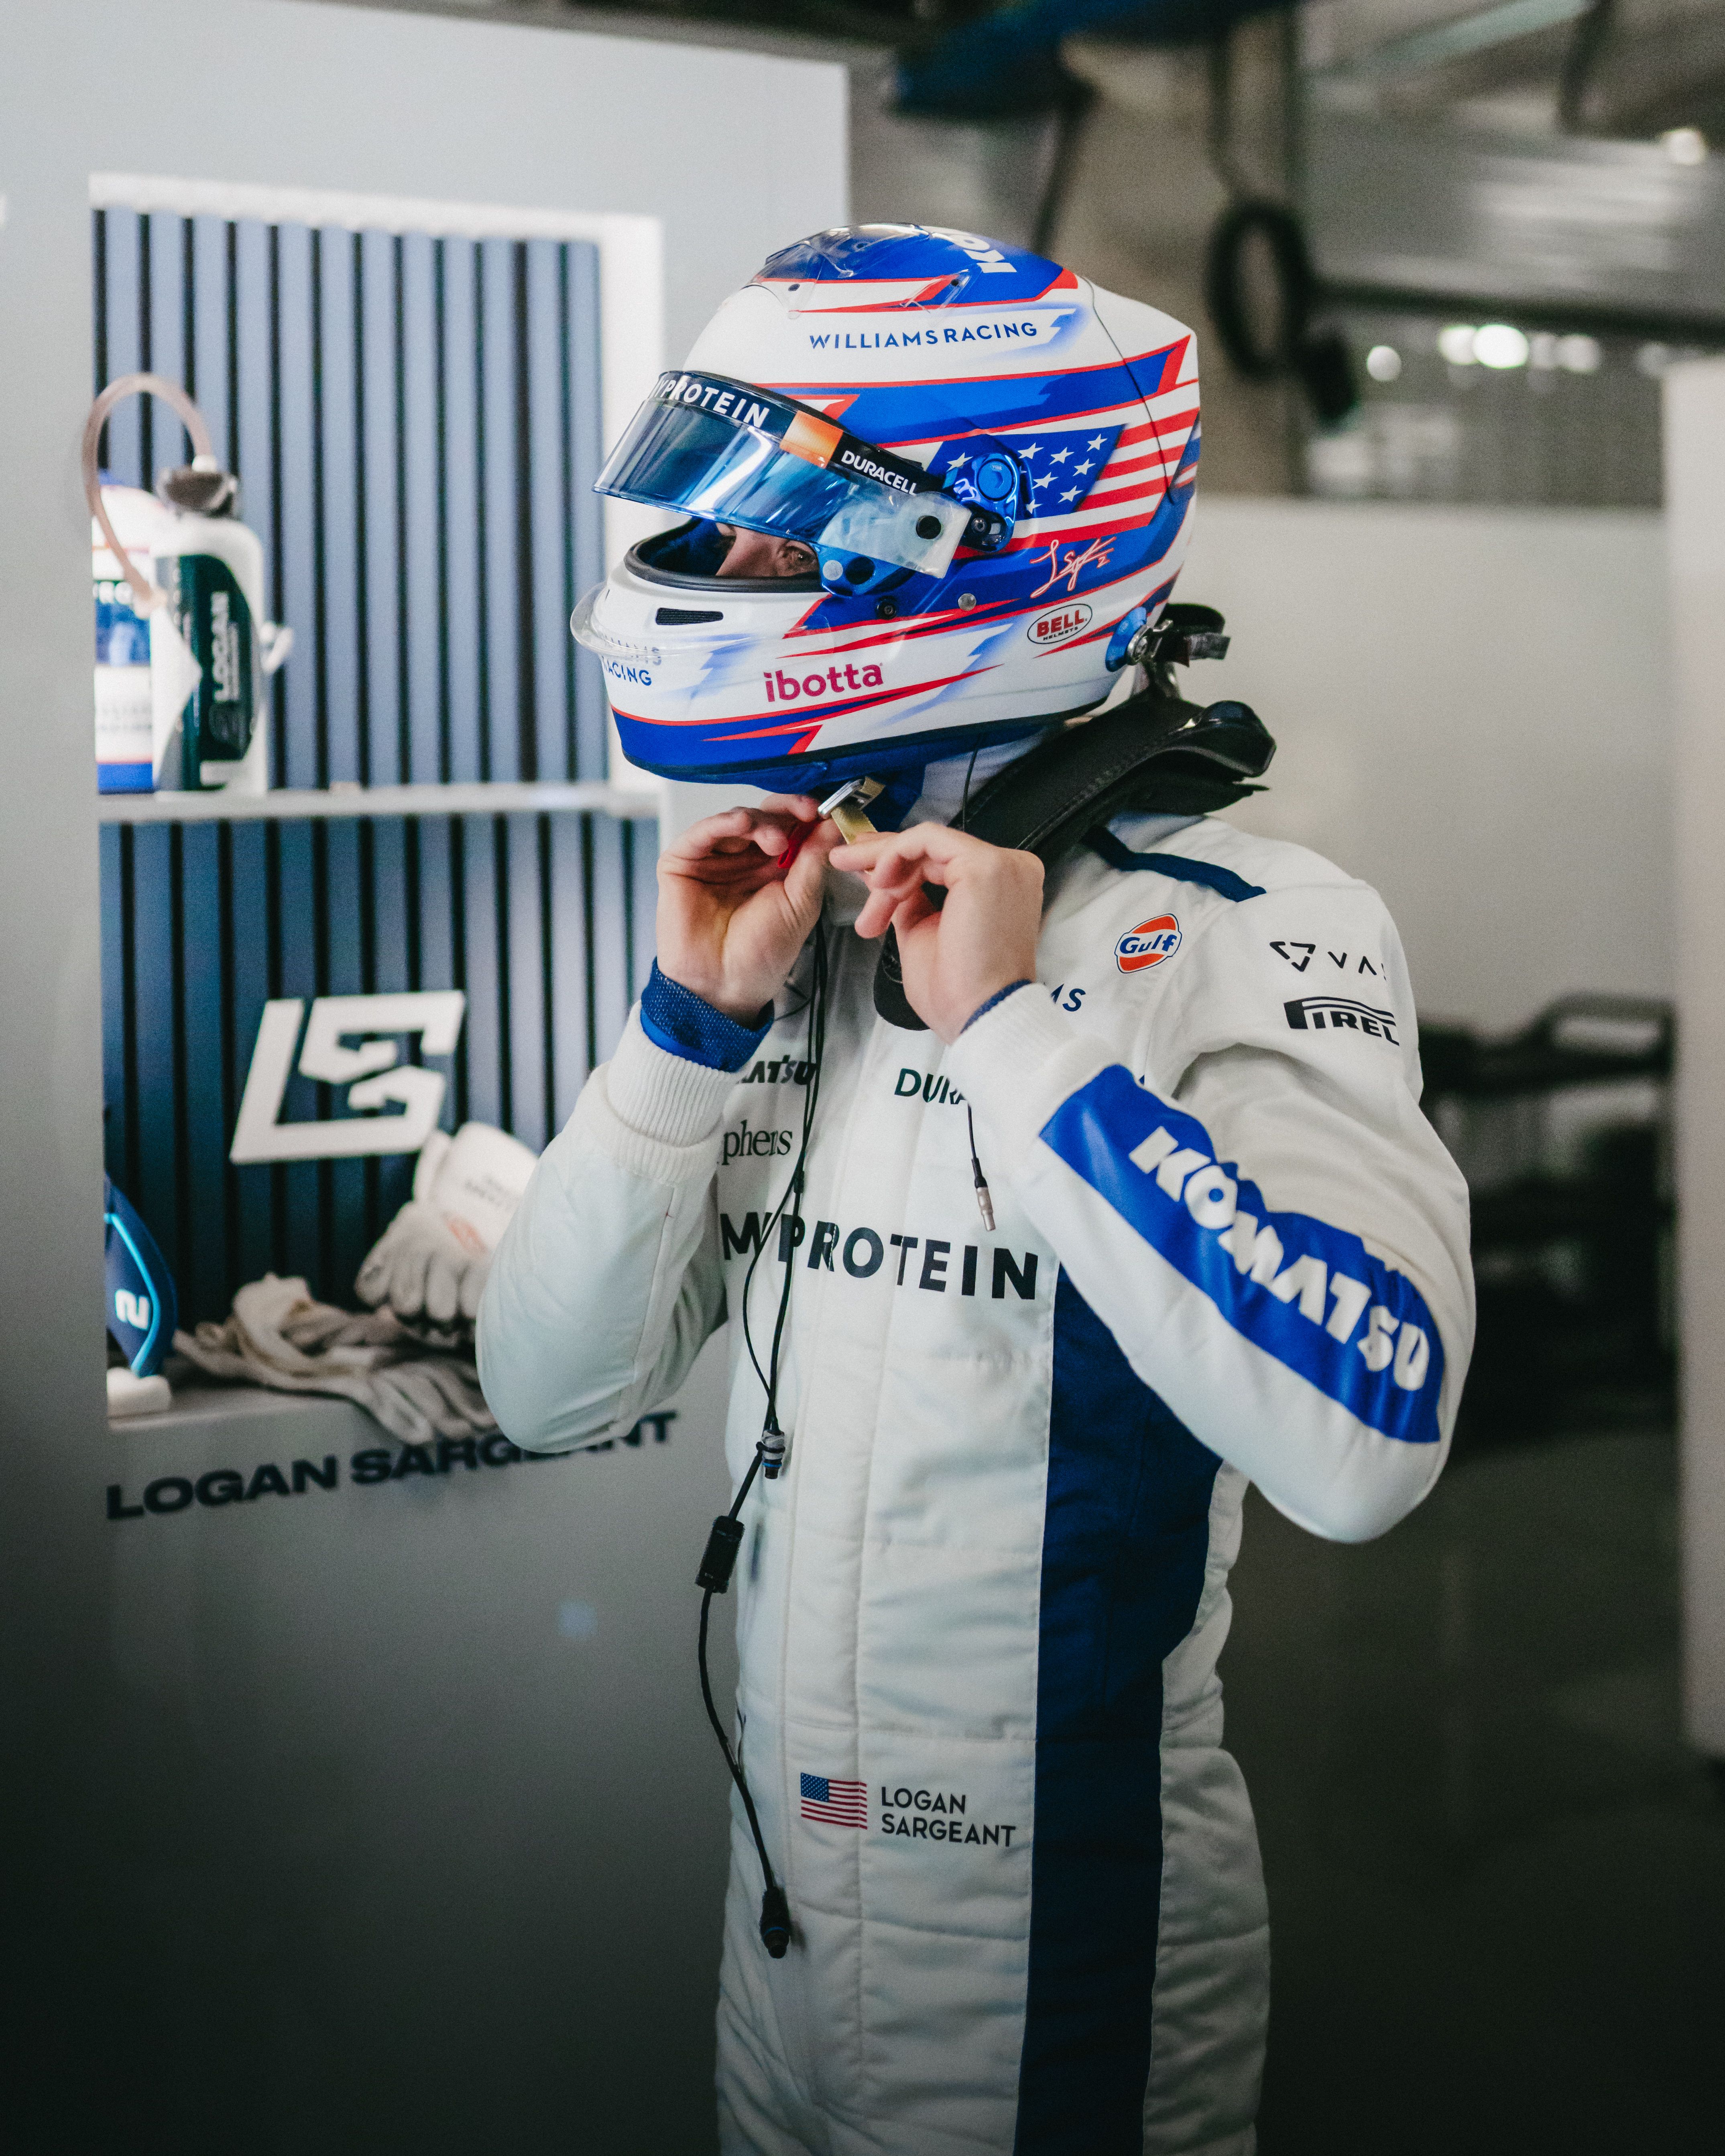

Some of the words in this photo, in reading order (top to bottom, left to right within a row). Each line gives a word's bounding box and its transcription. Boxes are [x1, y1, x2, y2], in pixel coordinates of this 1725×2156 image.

[809, 329, 940, 350] WILLIAMS
[944, 322, 1037, 343] RACING
[652, 378, 770, 428] YPROTEIN
[841, 450, 917, 496] DURACELL
[1037, 610, 1085, 638] BELL
[1043, 626, 1079, 641] HELMETS
[763, 663, 884, 702] ibotta
[1120, 934, 1177, 954] Gulf
[741, 1055, 816, 1085] ATSU
[1129, 1126, 1430, 1391] KOMATSU
[106, 1454, 337, 1519] LOGAN
[881, 1787, 966, 1814] LOGAN
[881, 1813, 1016, 1847] SARGEANT
